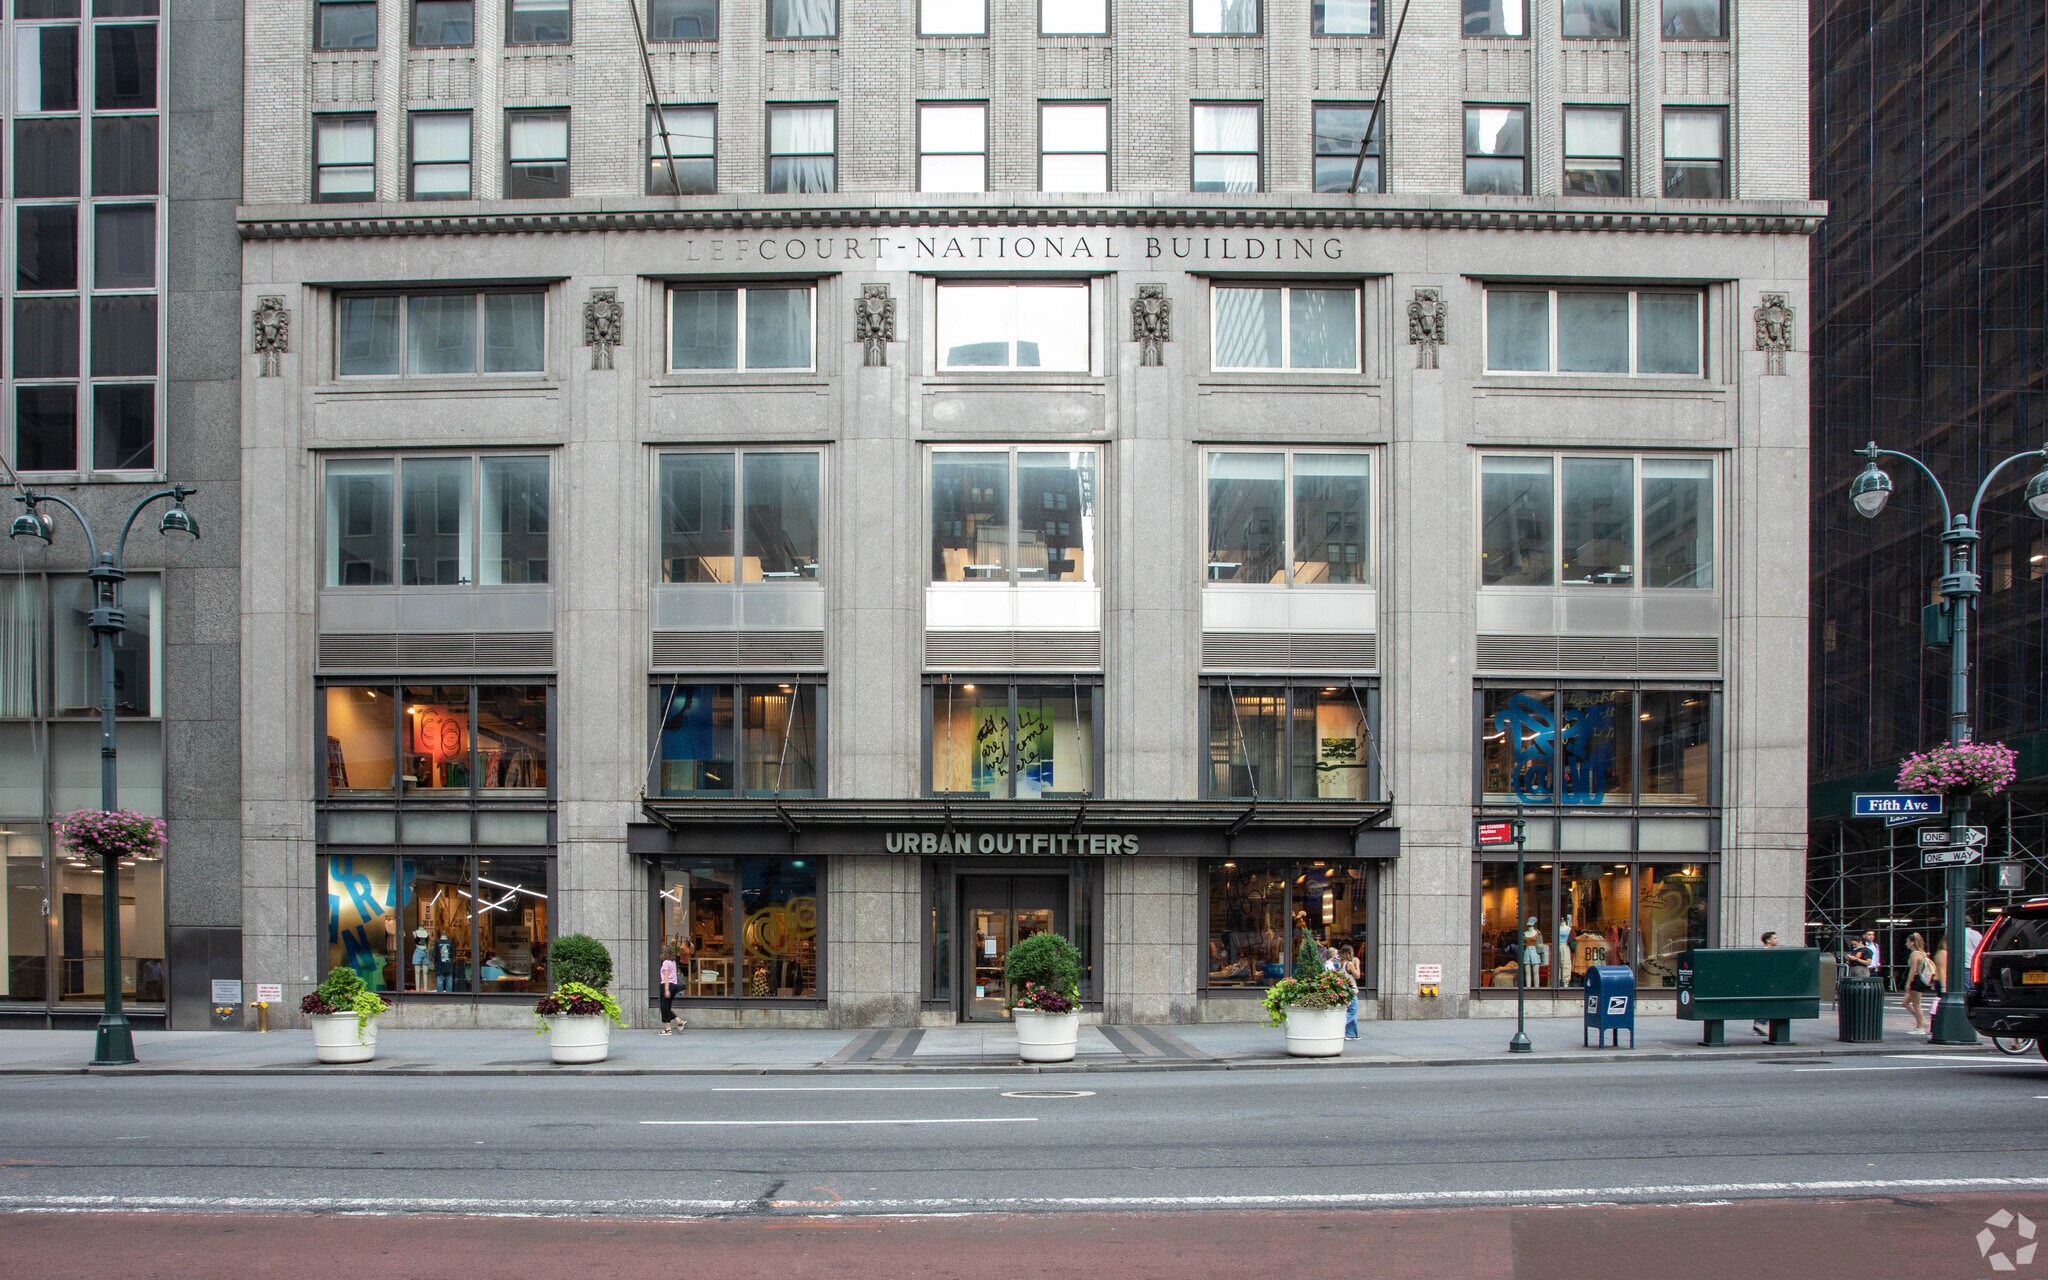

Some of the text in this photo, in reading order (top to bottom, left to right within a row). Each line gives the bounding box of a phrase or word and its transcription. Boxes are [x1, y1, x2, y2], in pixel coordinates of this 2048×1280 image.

[686, 237, 1344, 261] LEFCOURT-NATIONAL BUILDING
[981, 741, 1000, 758] are
[1869, 799, 1929, 811] Fifth Ave
[885, 832, 1140, 855] URBAN OUTFITTERS
[1924, 833, 1945, 841] ONE
[1926, 851, 1973, 862] ONE WAY
[1585, 946, 1606, 961] BDG
